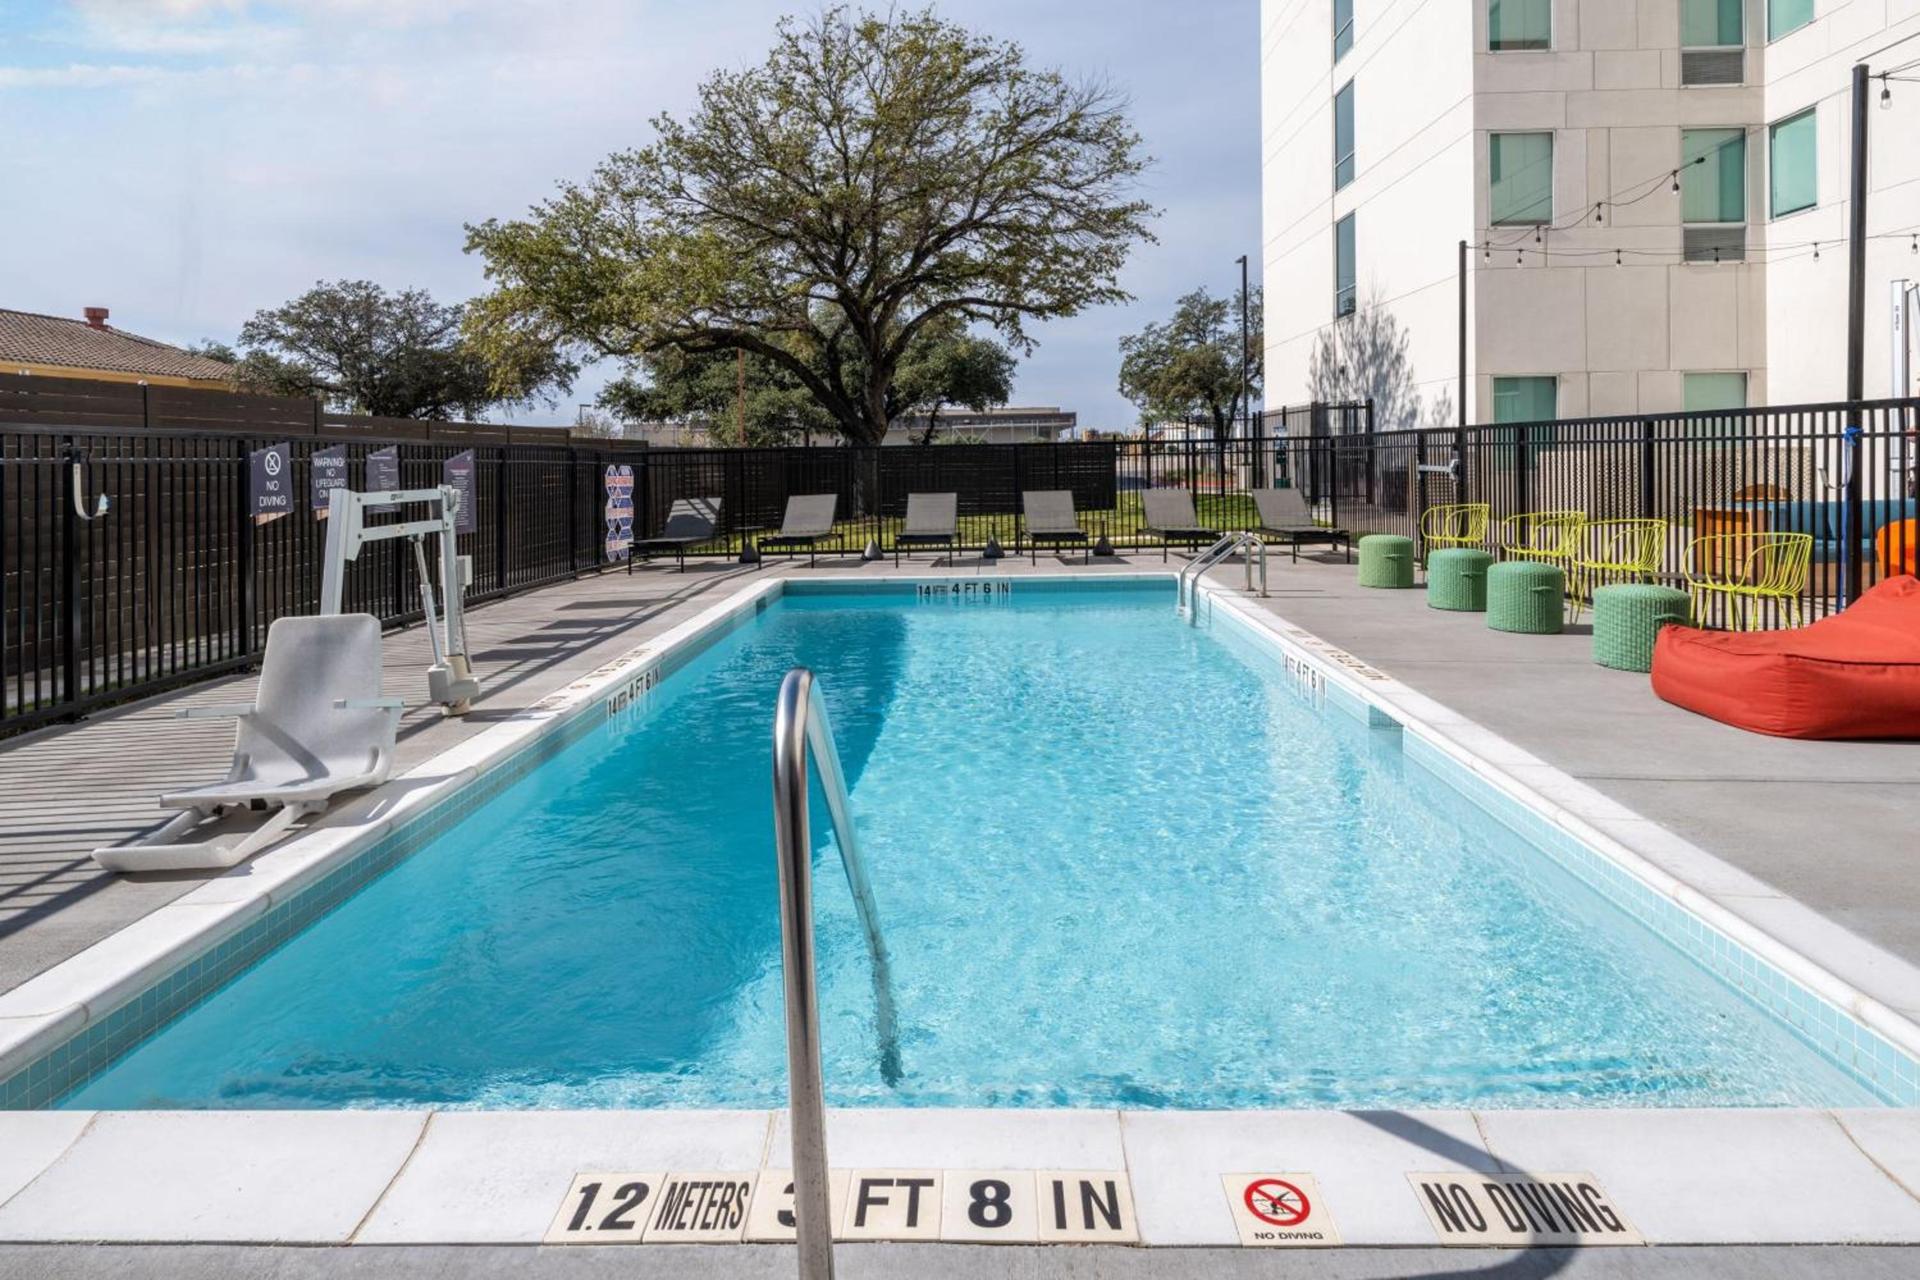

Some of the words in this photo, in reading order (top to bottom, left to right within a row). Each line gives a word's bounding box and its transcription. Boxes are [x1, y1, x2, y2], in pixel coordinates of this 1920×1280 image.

[266, 480, 279, 491] NO
[259, 495, 287, 507] DIVING
[952, 583, 960, 594] 4
[965, 582, 979, 594] FT
[983, 582, 992, 594] 6
[997, 582, 1009, 593] IN
[629, 683, 634, 701] 4
[635, 676, 644, 698] FT
[645, 672, 651, 690] 6
[566, 1182, 650, 1231] 1.2
[653, 1181, 750, 1230] METERS
[854, 1178, 935, 1228] FT
[967, 1179, 1013, 1228] 8
[1052, 1180, 1122, 1230] IN
[1421, 1182, 1488, 1233] NO
[1482, 1182, 1626, 1233] DIVING
[1254, 1232, 1275, 1240] NO
[1278, 1232, 1324, 1240] DIVING
